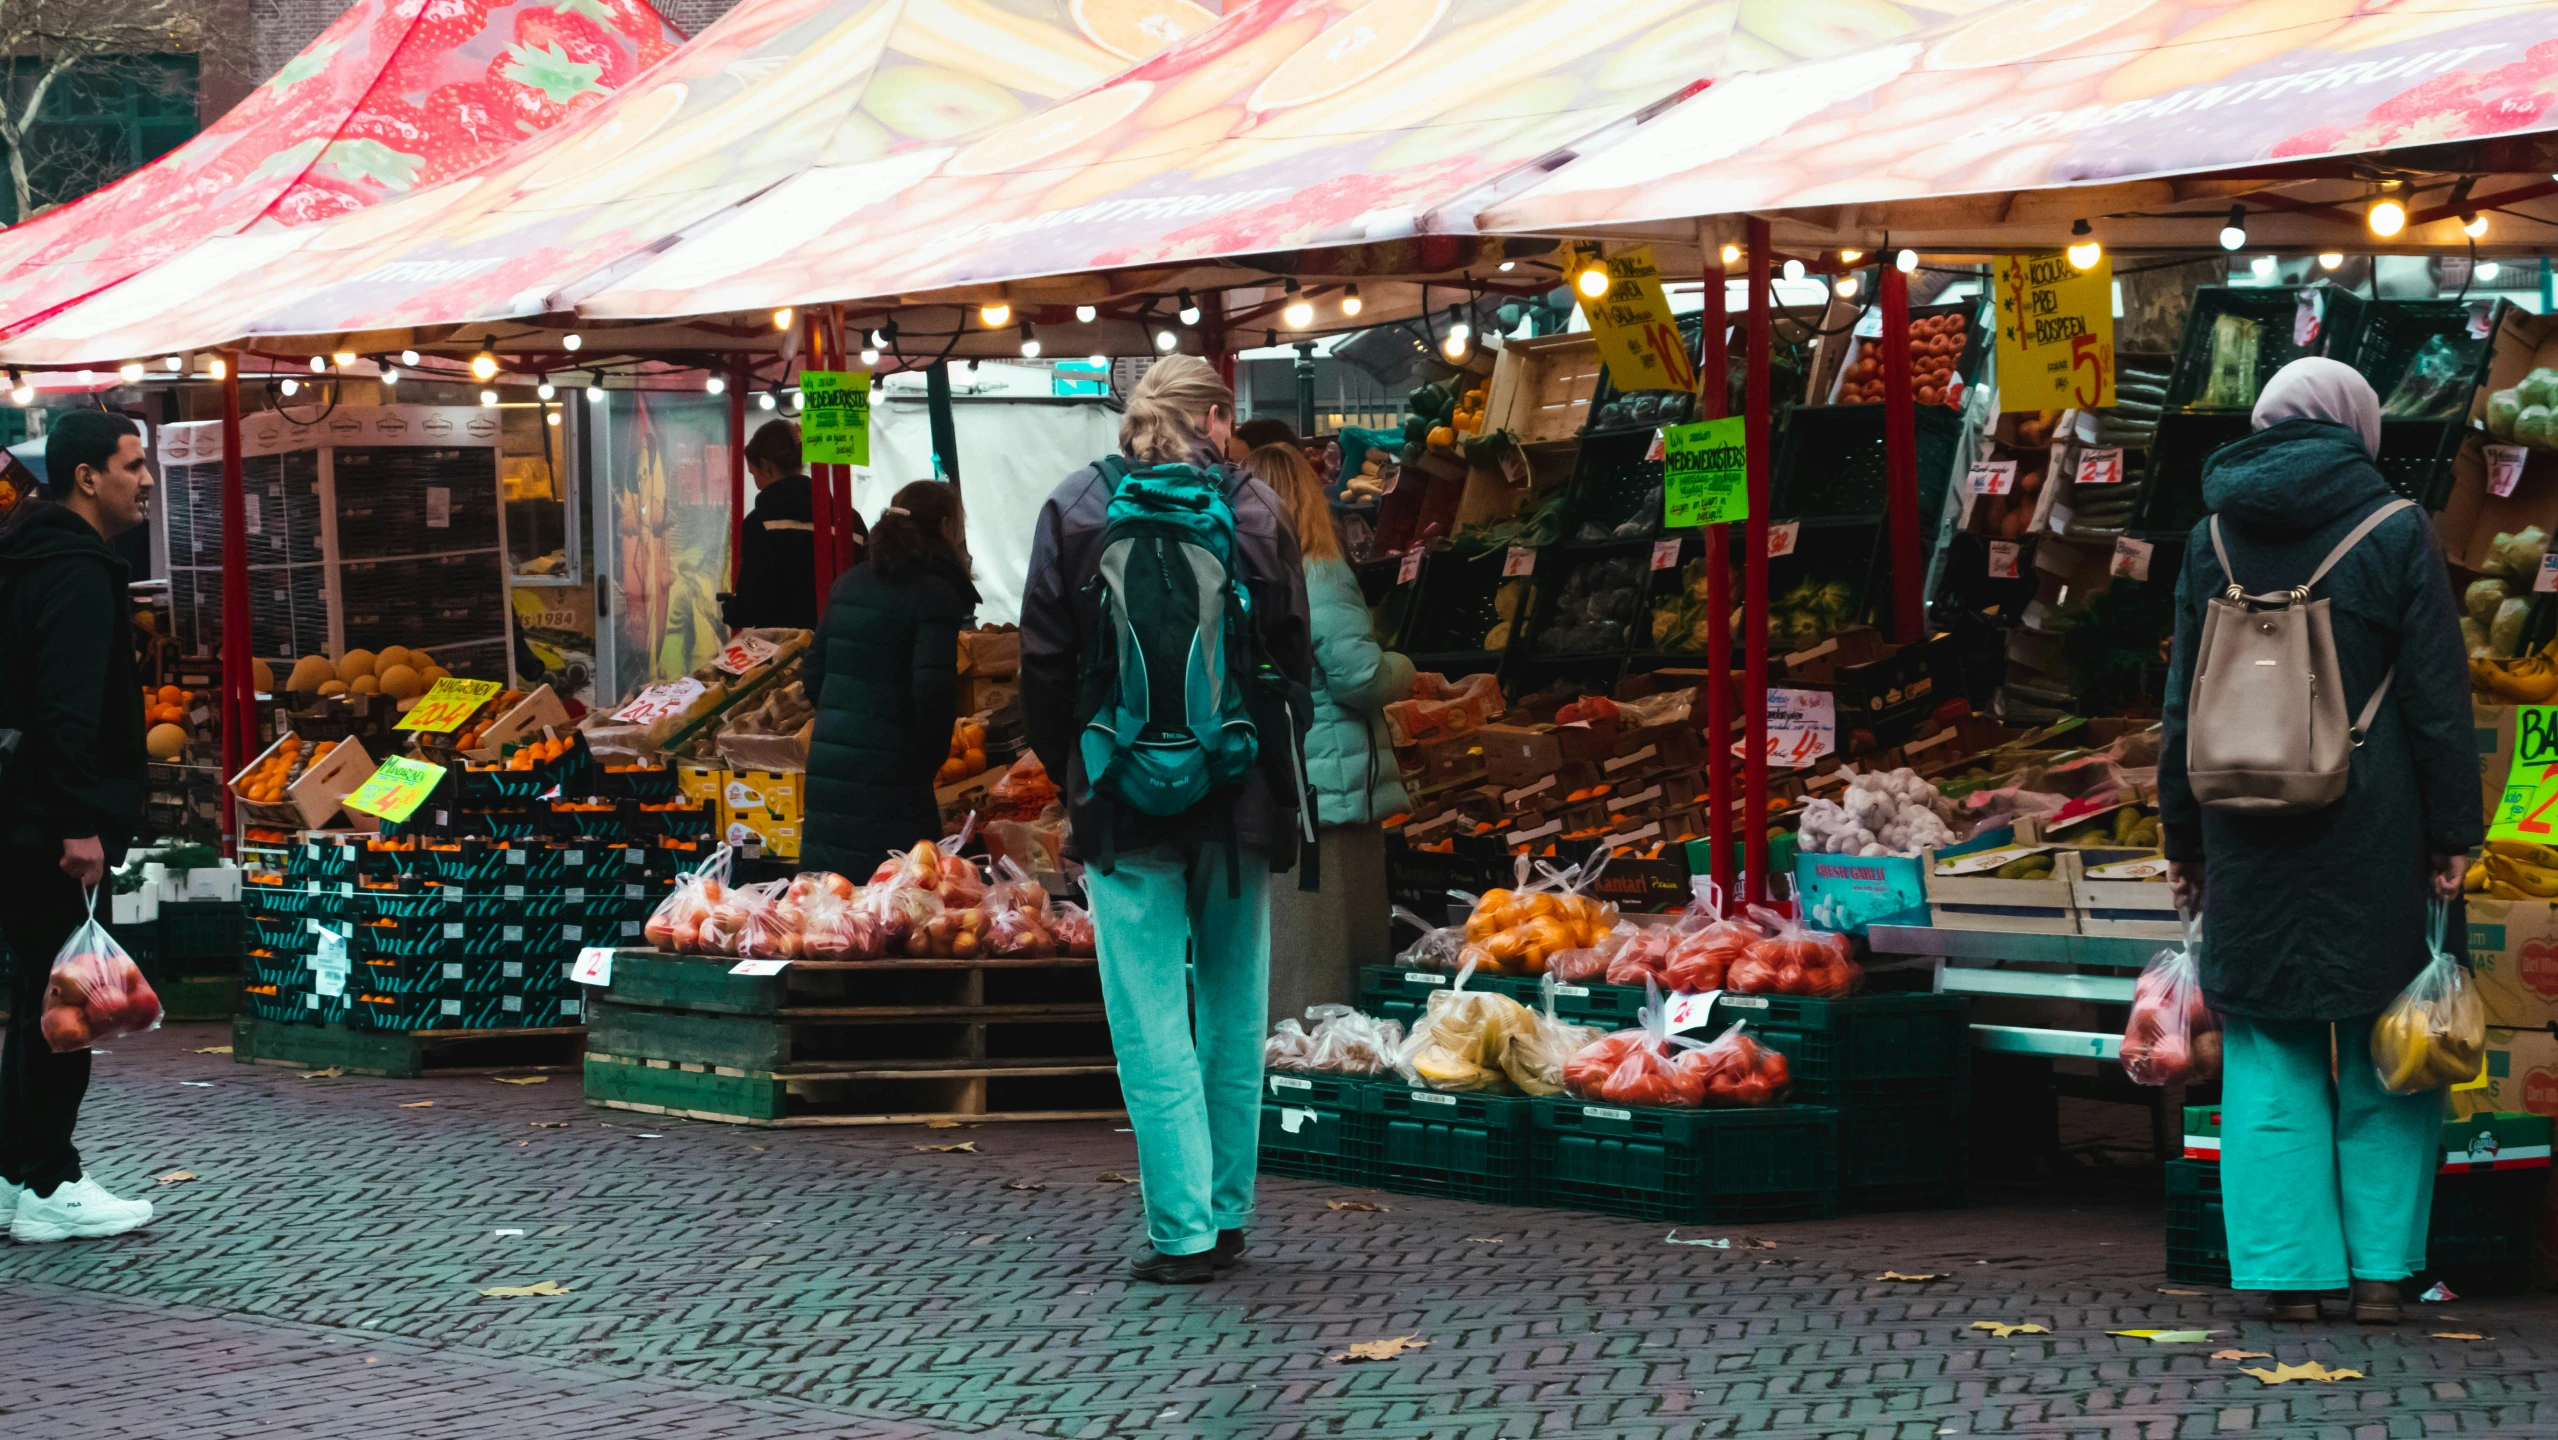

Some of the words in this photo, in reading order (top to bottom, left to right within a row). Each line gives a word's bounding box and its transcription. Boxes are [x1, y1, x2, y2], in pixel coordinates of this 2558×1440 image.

[2032, 290, 2058, 316] PREI
[2035, 316, 2087, 343] BOSPEEN
[1643, 322, 1694, 392] 10
[2071, 333, 2102, 409] 5
[1665, 444, 1746, 473] MEDEWERKSTERS
[536, 612, 574, 626] 1984
[620, 700, 655, 721] 20
[2519, 707, 2558, 761] BA
[1791, 730, 1818, 766] 4
[1594, 872, 1649, 894] Kantari
[1815, 863, 1848, 879] FRESH
